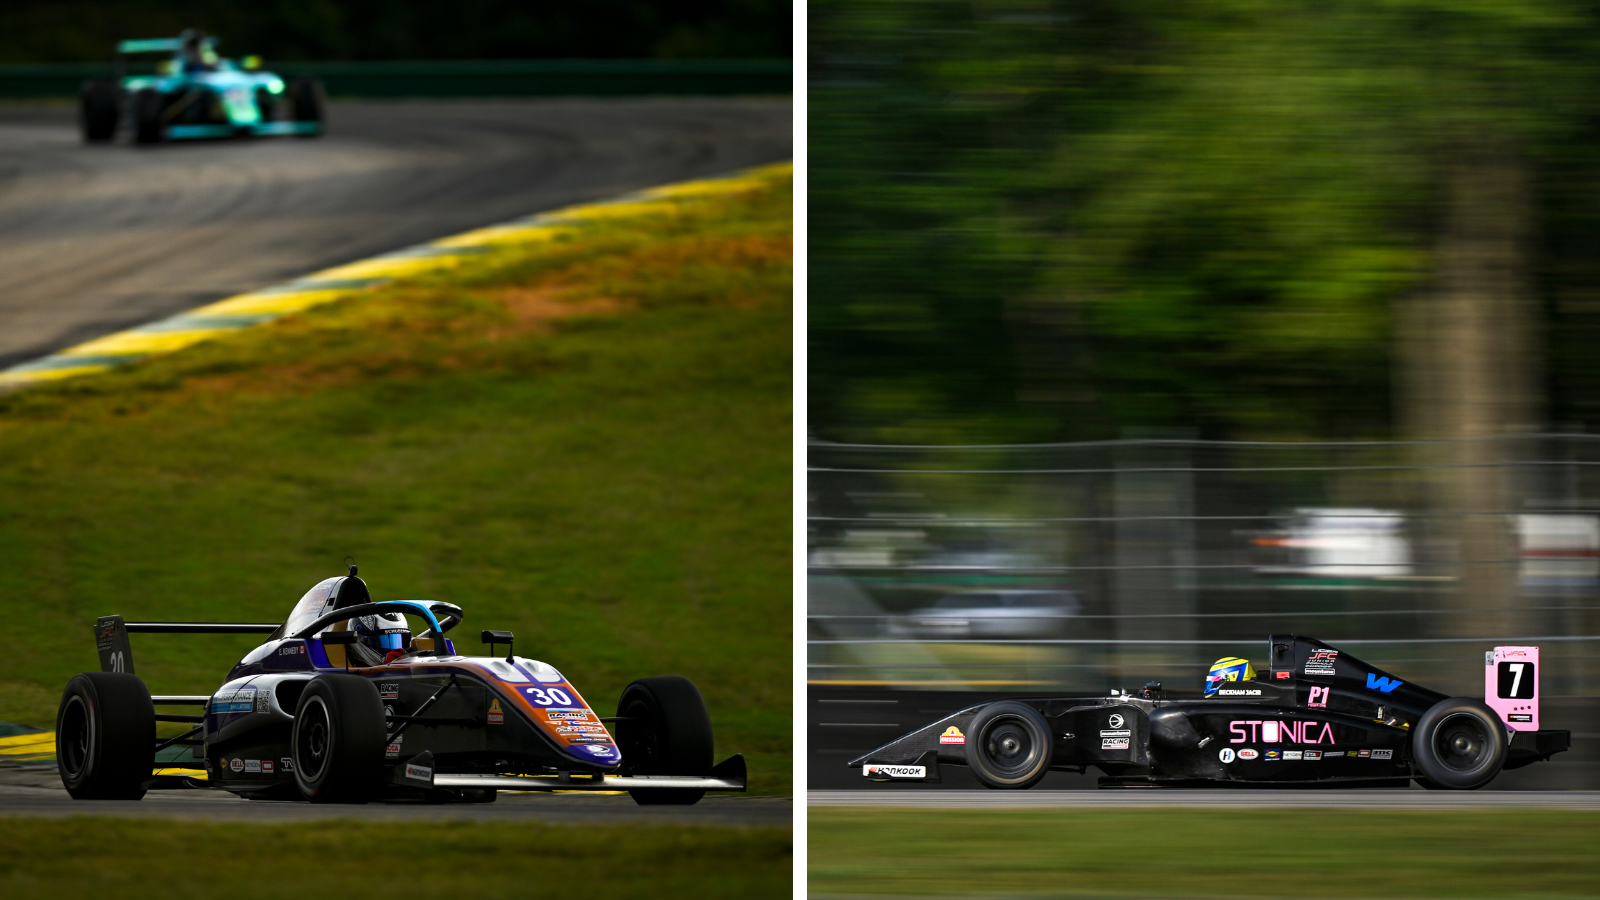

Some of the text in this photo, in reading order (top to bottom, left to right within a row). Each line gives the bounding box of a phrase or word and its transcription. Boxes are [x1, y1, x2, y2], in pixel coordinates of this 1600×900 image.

[1308, 652, 1339, 660] JFC
[1509, 663, 1525, 697] 7
[526, 687, 572, 706] 30
[1308, 686, 1330, 704] P1
[1229, 720, 1336, 745] STONICA
[231, 760, 243, 768] BELL
